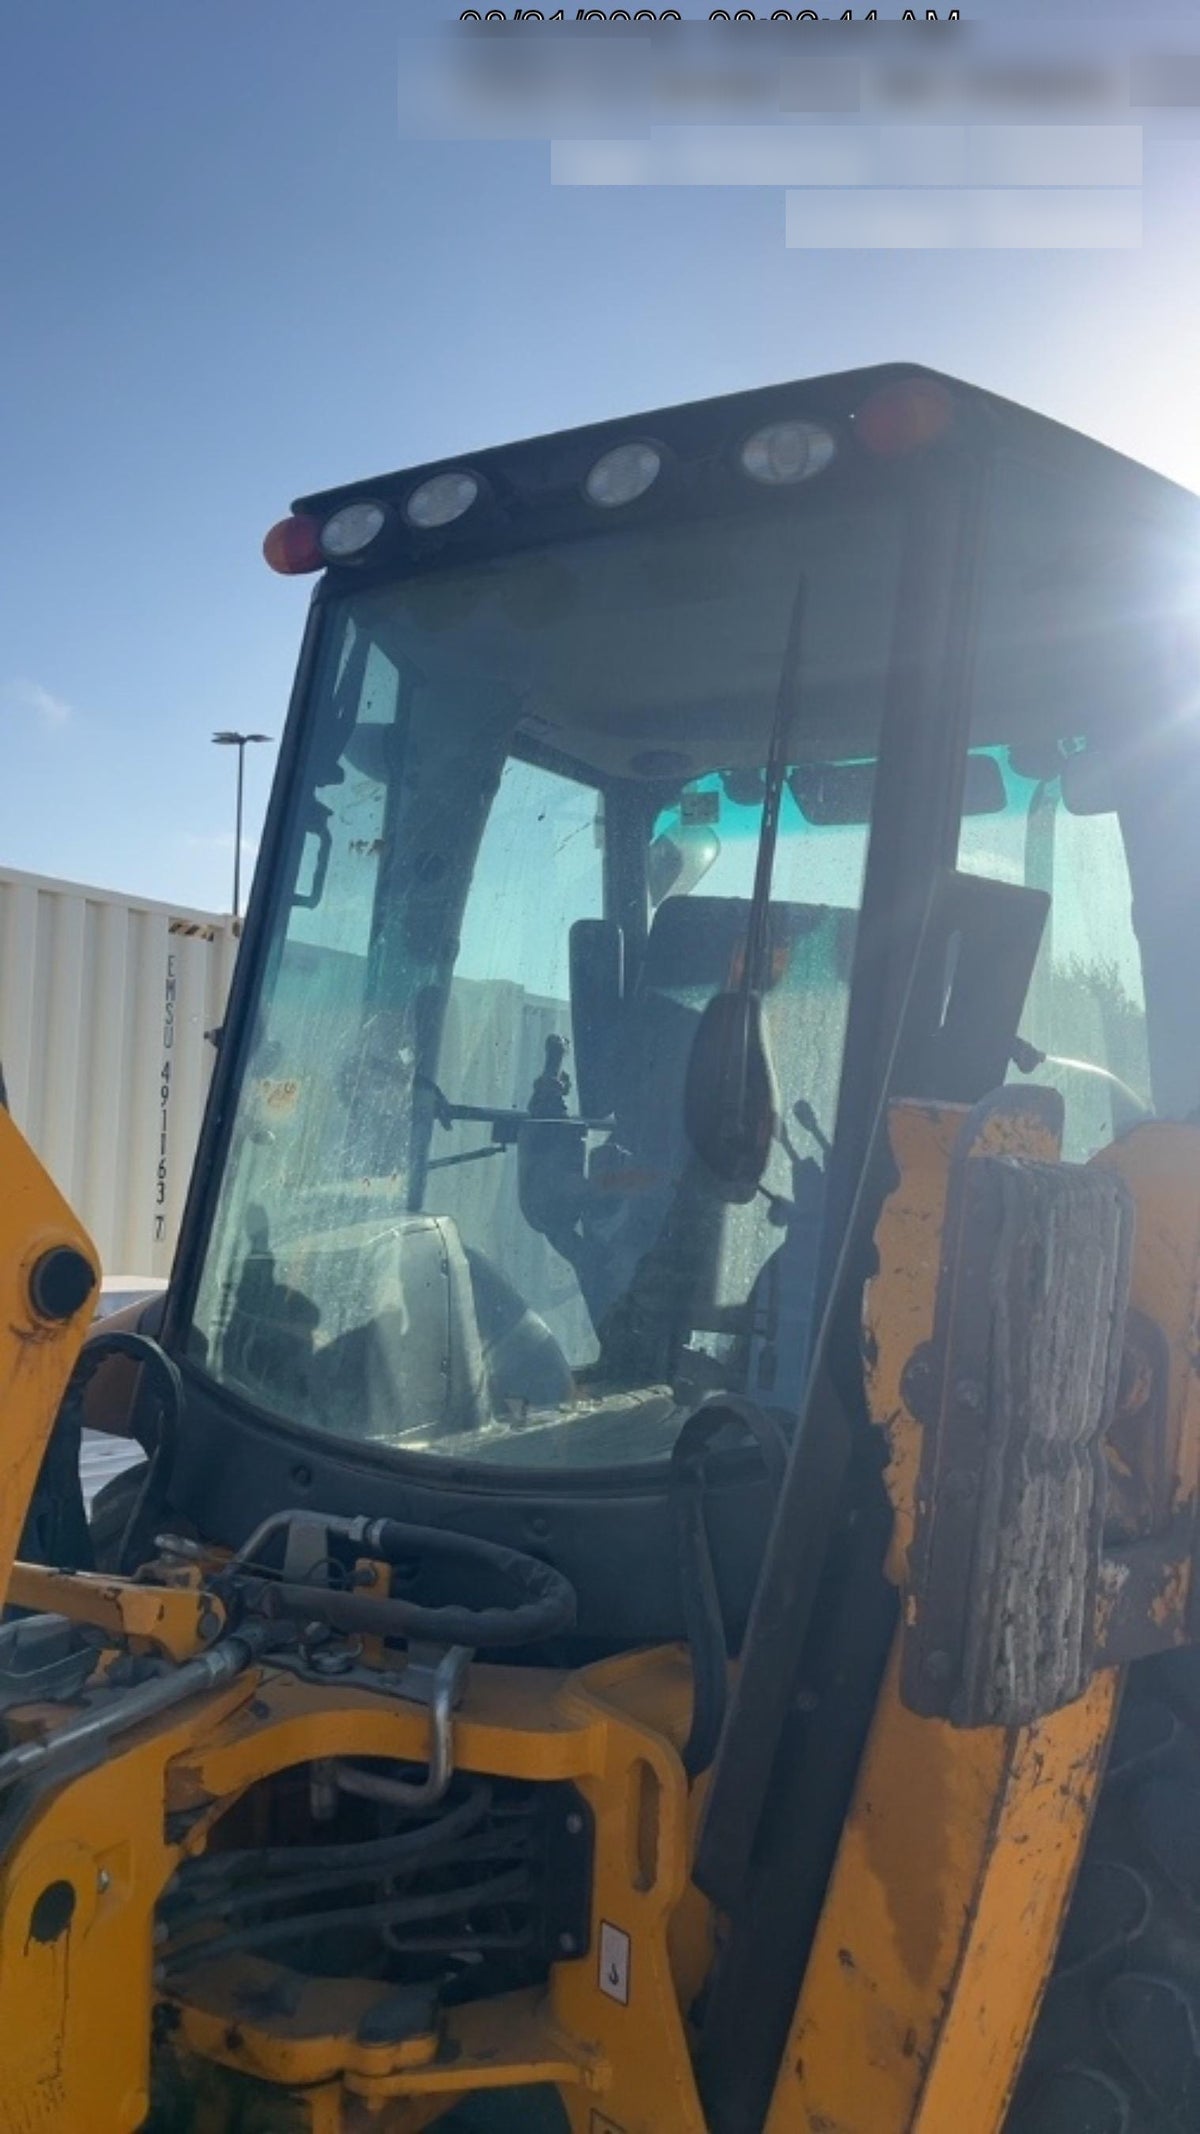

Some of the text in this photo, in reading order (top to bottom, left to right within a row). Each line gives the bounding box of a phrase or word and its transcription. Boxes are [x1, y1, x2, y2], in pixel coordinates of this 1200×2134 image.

[155, 955, 176, 1240] EMSU 491163 7
